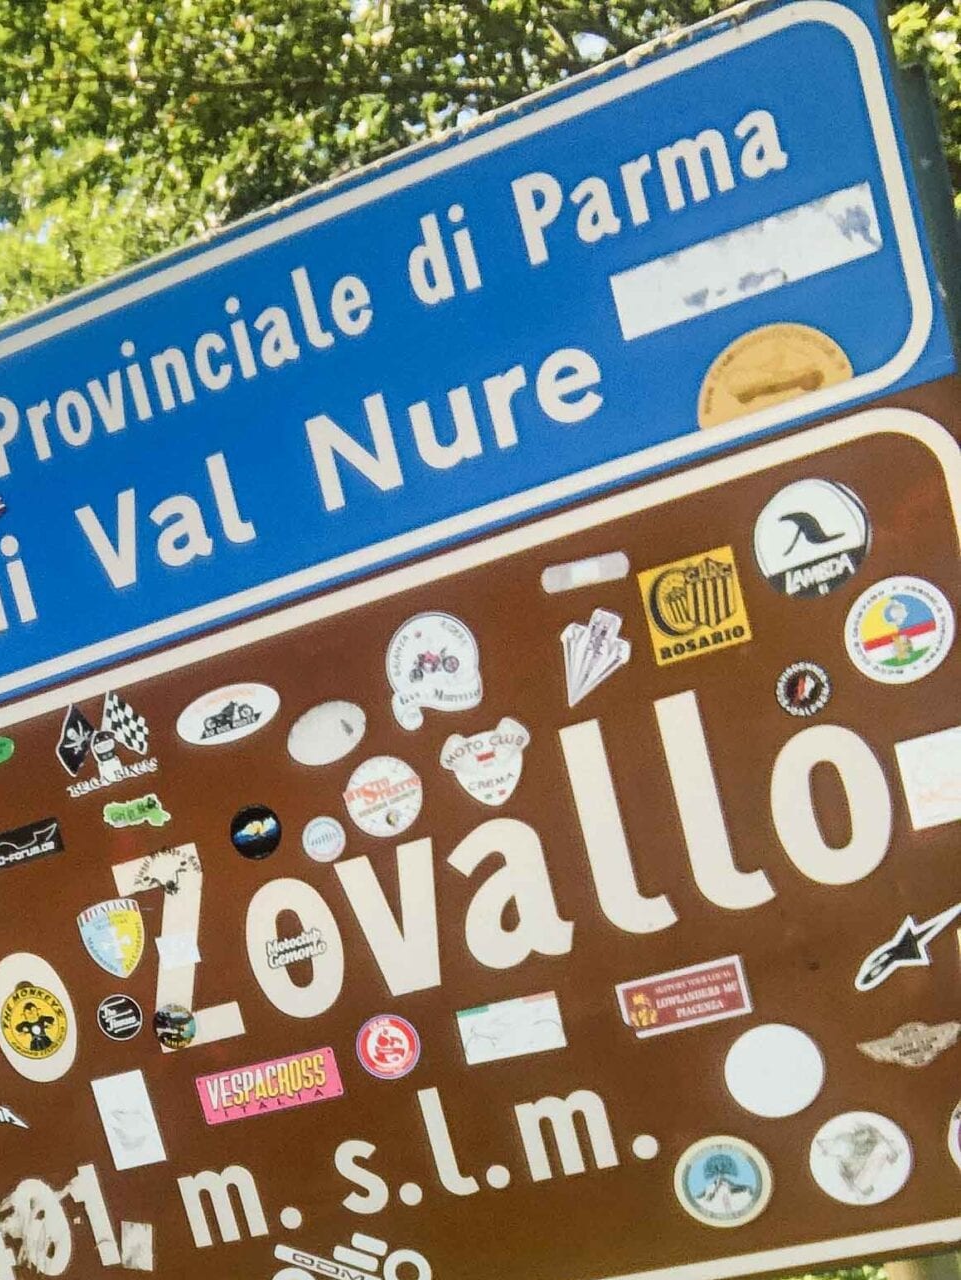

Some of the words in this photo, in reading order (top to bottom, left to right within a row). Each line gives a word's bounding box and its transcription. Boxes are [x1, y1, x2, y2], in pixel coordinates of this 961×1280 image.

[408, 204, 484, 306] di
[511, 109, 789, 266] Parma
[75, 452, 257, 590] Val
[303, 348, 604, 512] Nure
[659, 624, 745, 661] ROSARIO
[444, 739, 484, 767] MOTO
[488, 734, 526, 749] CLUB
[467, 772, 515, 793] CREMA
[111, 689, 892, 1053] Zovallo
[265, 927, 322, 957] Motoclub
[2, 1002, 15, 1030] THE
[12, 987, 64, 1018] MONKEYS
[656, 985, 720, 1009] LOWLANDERS
[205, 1053, 327, 1111] VESPACROSS
[224, 1088, 325, 1119] ITALIA
[176, 1165, 303, 1249] m.
[334, 1086, 660, 1215] s.l.m.
